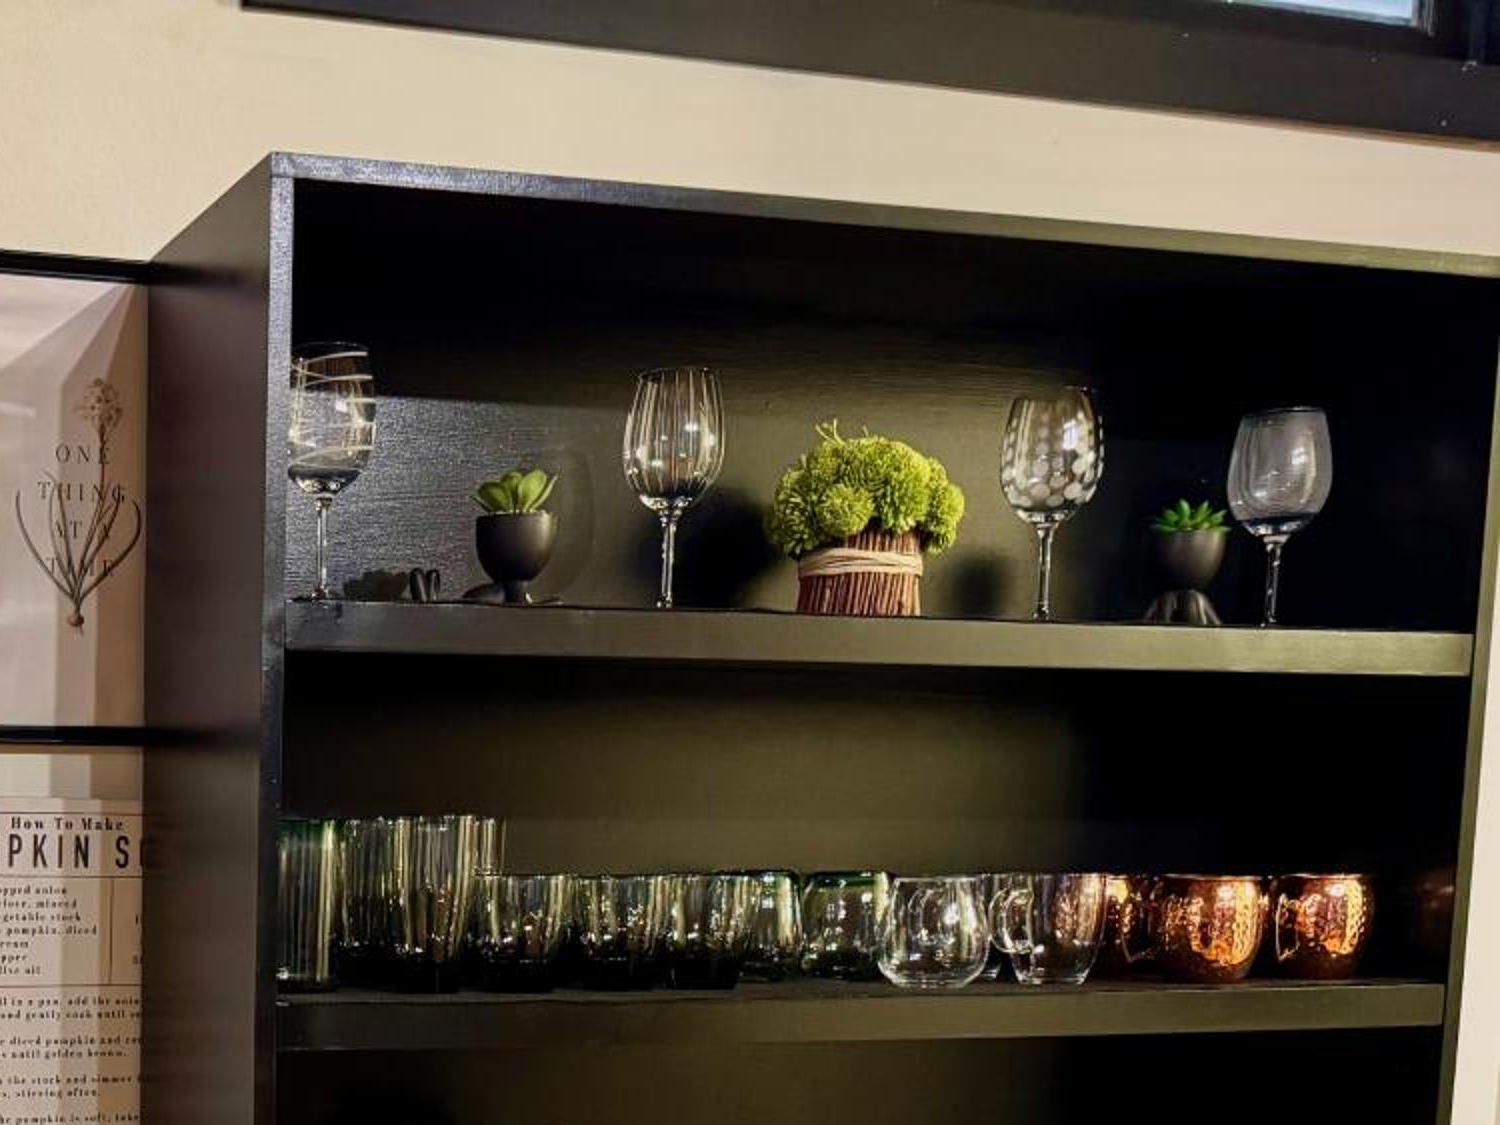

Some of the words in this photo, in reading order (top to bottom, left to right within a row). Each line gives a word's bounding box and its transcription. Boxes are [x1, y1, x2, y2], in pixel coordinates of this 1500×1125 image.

[55, 444, 110, 465] ONE
[11, 816, 45, 830] How
[55, 817, 73, 830] To
[83, 817, 125, 831] Make
